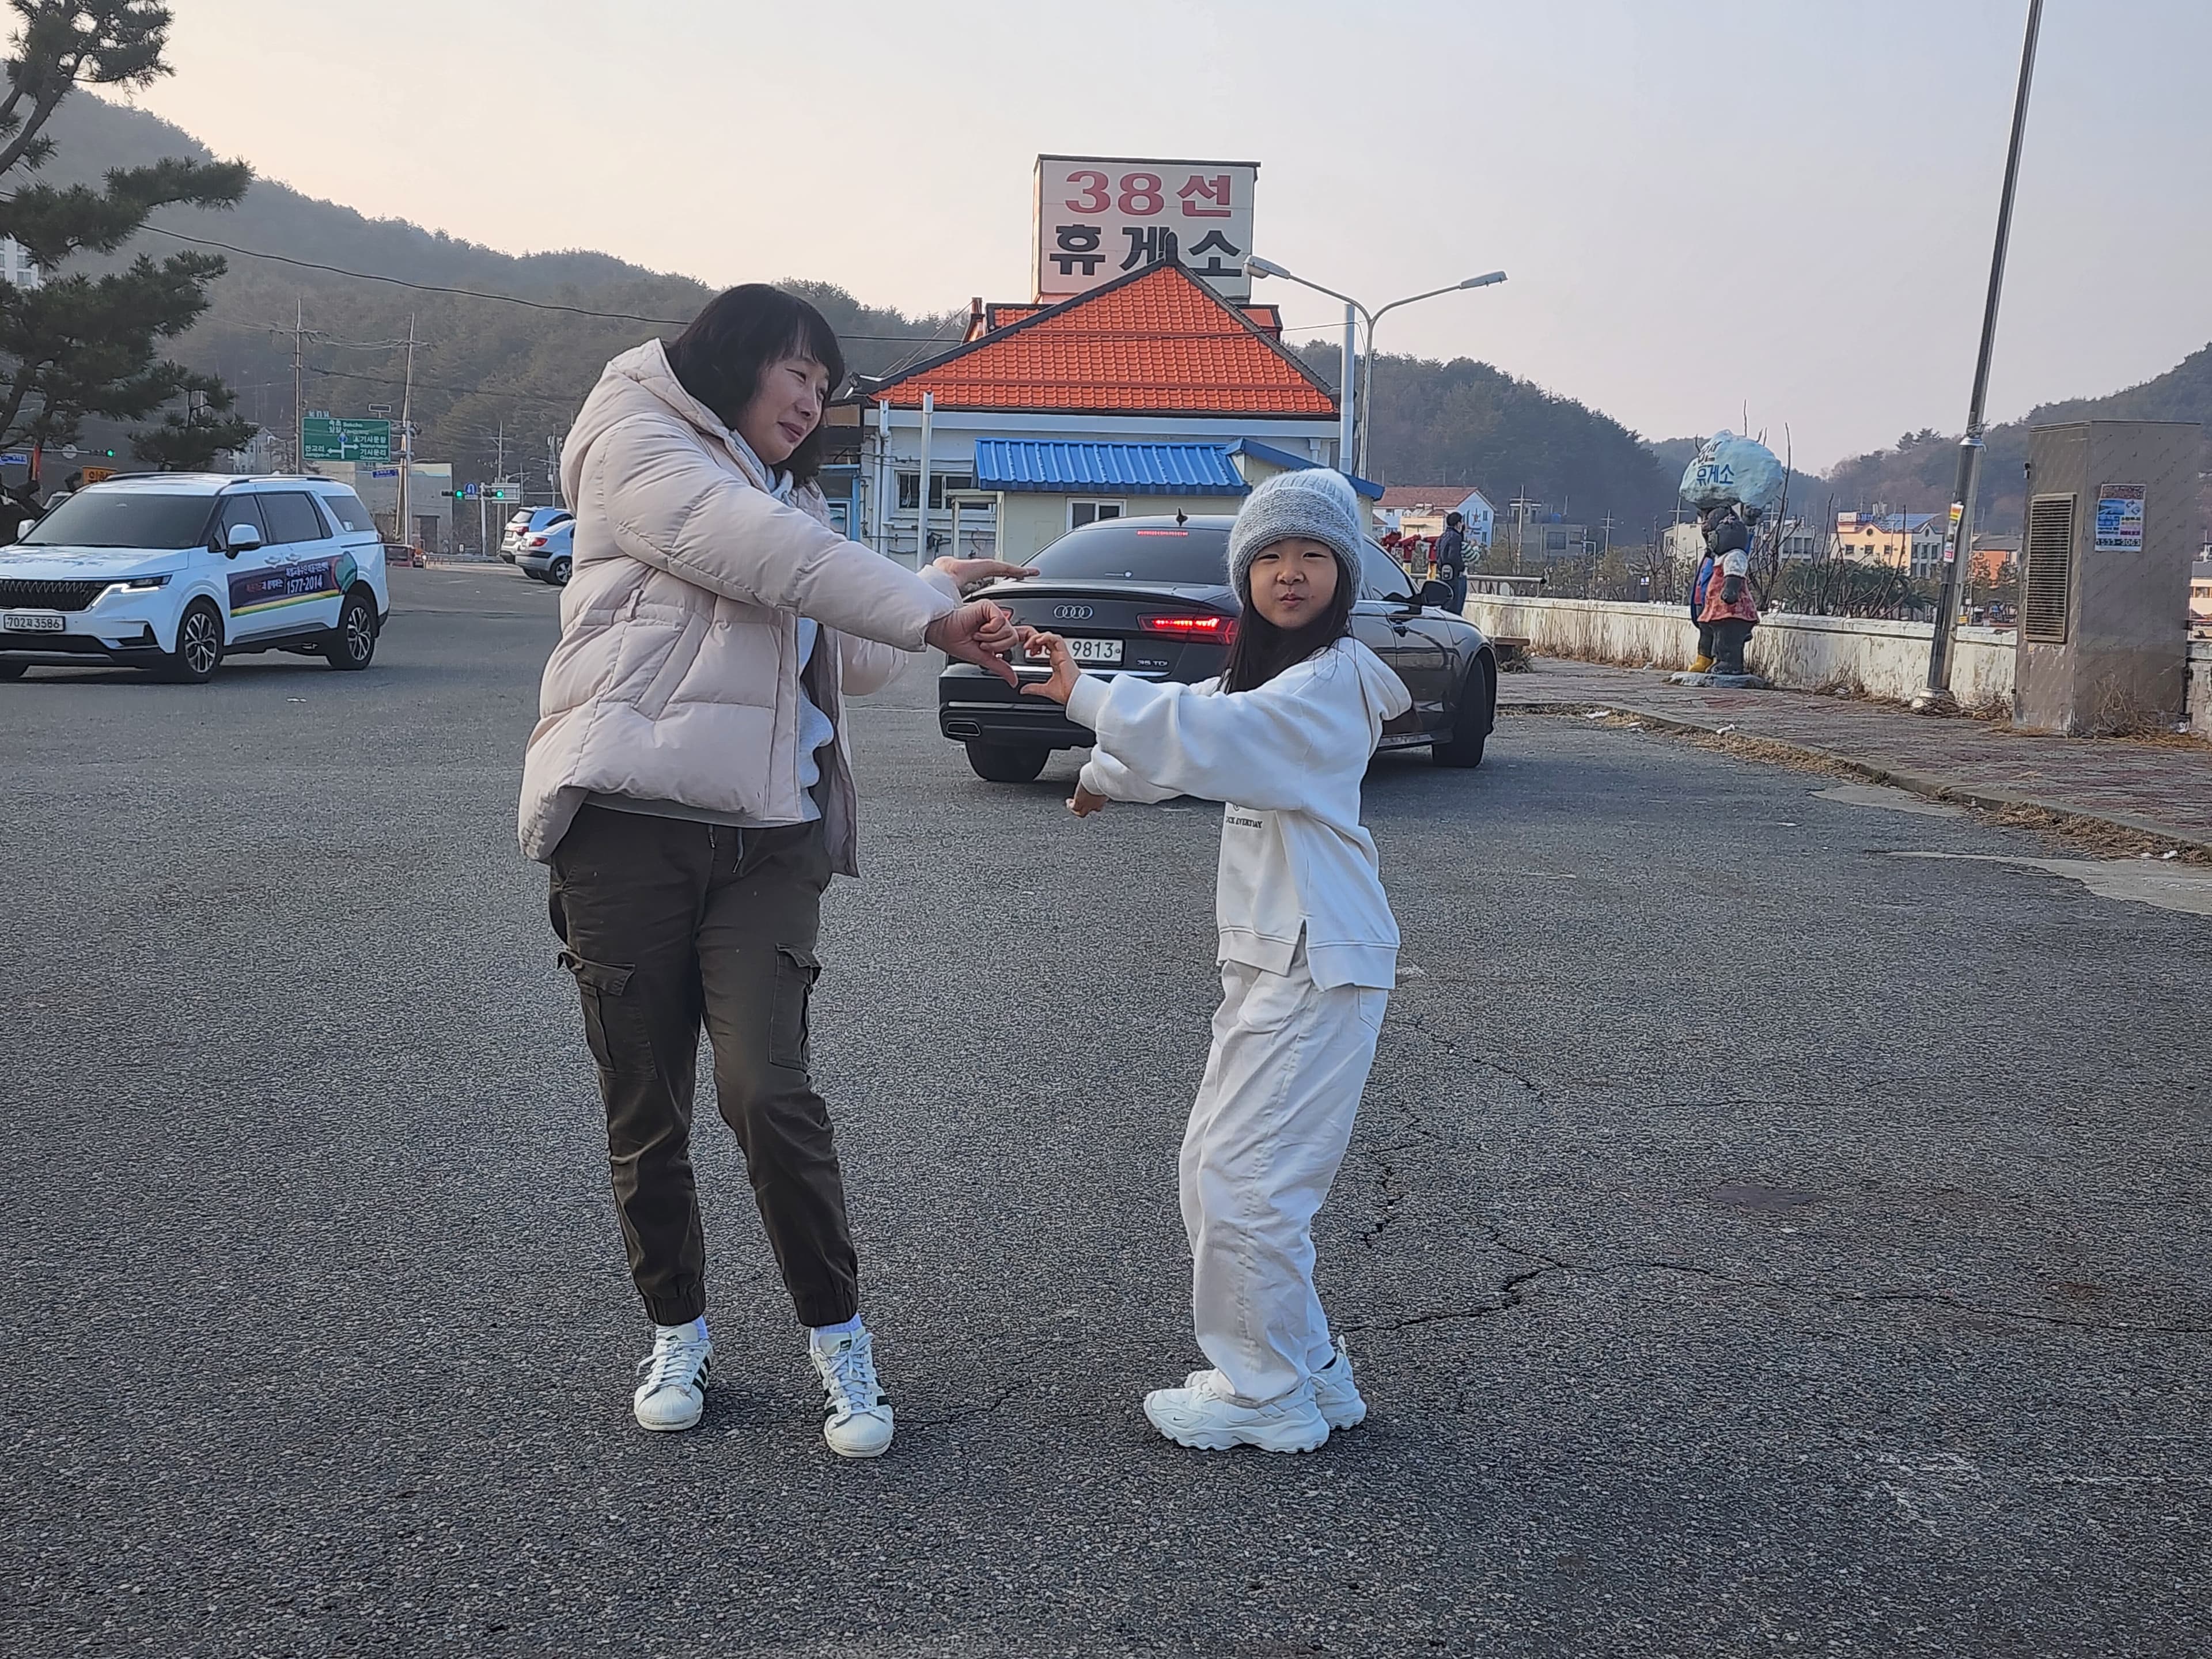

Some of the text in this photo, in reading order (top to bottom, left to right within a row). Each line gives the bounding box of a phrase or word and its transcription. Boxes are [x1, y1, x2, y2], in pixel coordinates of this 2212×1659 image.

[1065, 170, 1232, 217] 38선
[1050, 224, 1242, 276] 휴게소
[1696, 462, 1734, 486] 휴게소
[286, 574, 323, 594] 1577-2014
[1072, 641, 1114, 658] 9813
